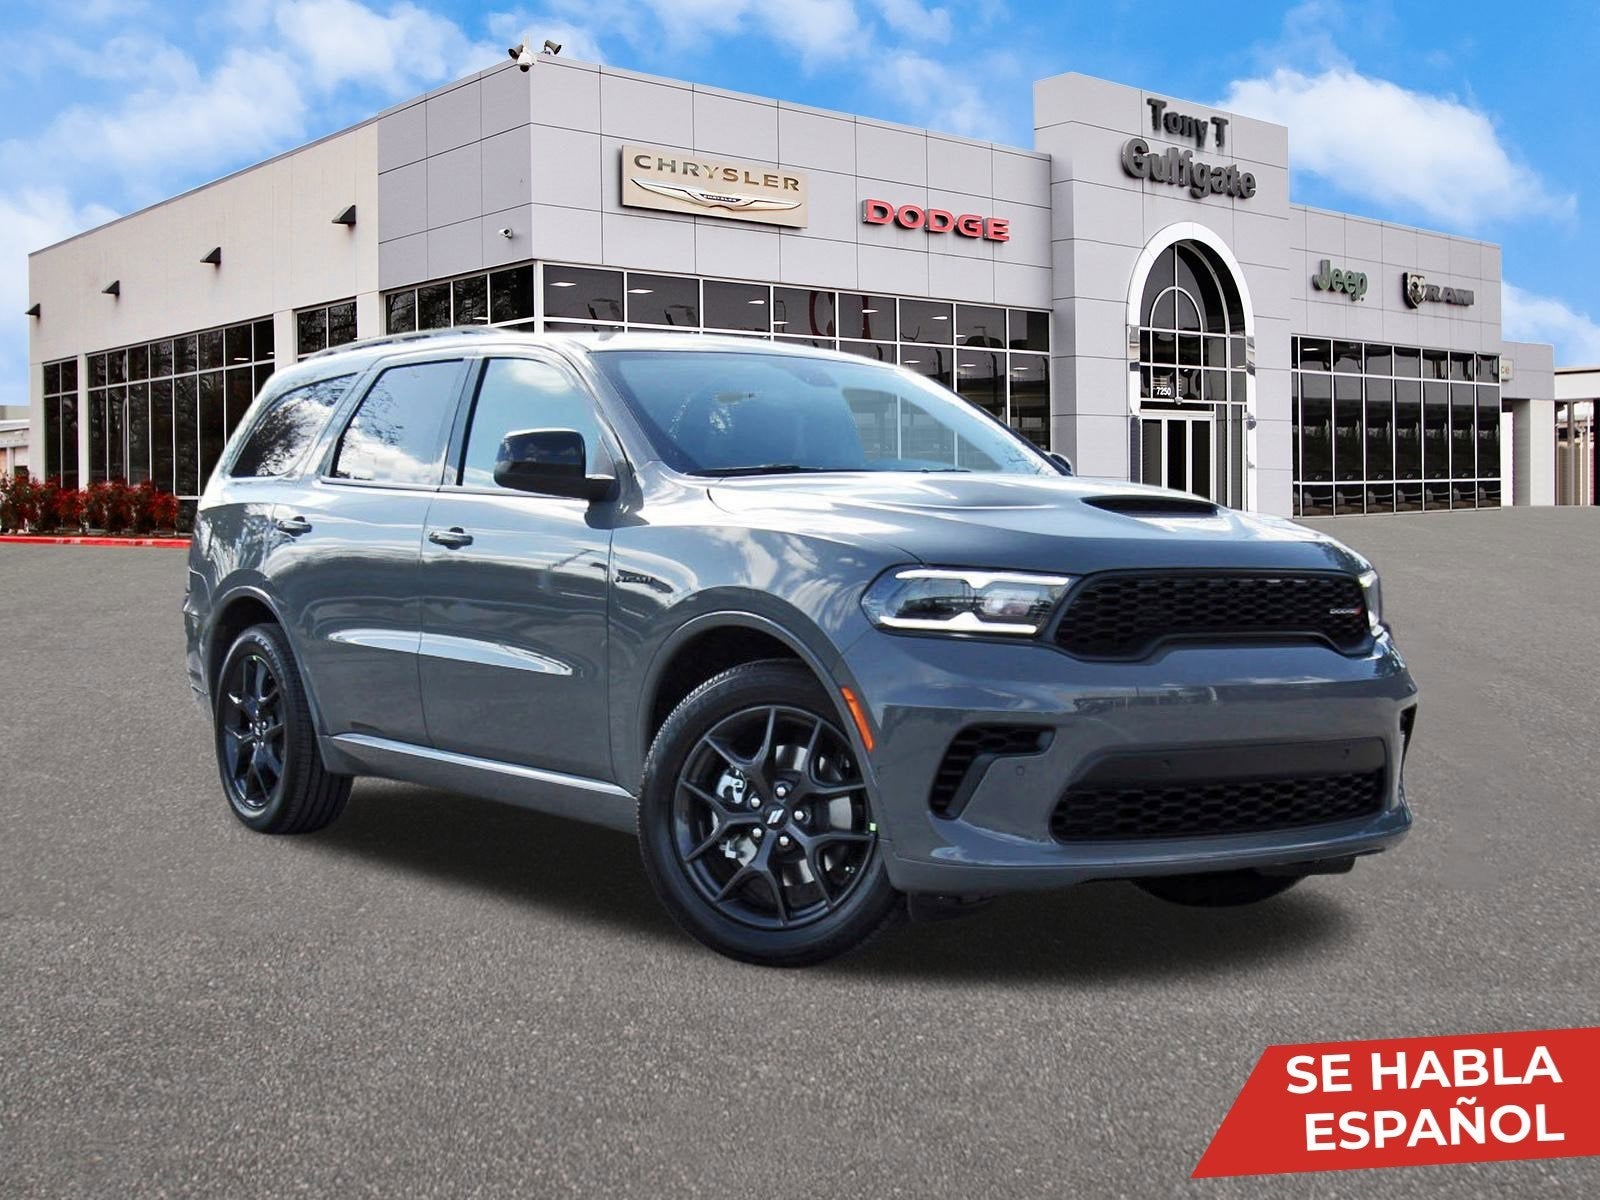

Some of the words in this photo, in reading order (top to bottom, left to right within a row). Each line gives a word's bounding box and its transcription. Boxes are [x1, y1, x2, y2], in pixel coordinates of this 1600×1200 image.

[1147, 98, 1208, 147] Tony
[1210, 116, 1229, 147] T
[634, 154, 800, 191] CHRYSLER
[1121, 138, 1256, 198] Gulfgate
[863, 199, 1010, 241] DODGE
[1312, 259, 1368, 301] Jeep
[1425, 284, 1474, 306] RAM
